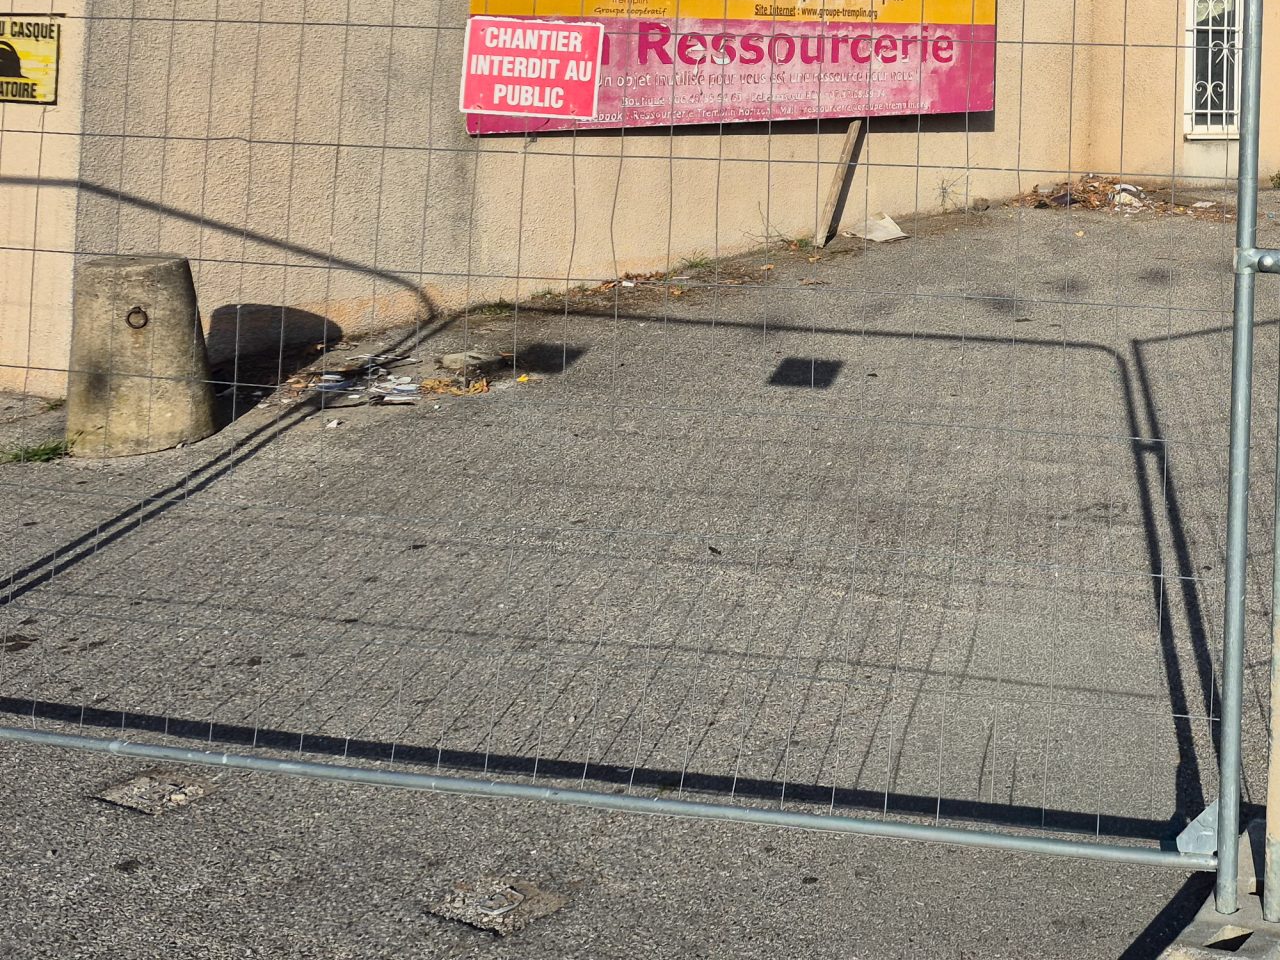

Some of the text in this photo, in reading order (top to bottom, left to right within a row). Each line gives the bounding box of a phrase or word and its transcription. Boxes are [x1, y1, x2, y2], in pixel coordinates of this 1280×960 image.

[594, 6, 668, 17] Groupe coopératif
[754, 3, 768, 16] Site
[768, 4, 796, 18] Internet
[801, 6, 878, 20] www.groupe-tremplin.org
[10, 21, 55, 42] CASQUE
[484, 26, 583, 53] CHANTIER
[637, 21, 955, 66] Ressourcerie
[470, 54, 593, 82] INTERDIT AU
[616, 74, 652, 90] objet
[708, 73, 736, 88] pour
[493, 83, 565, 109] PUBLIC
